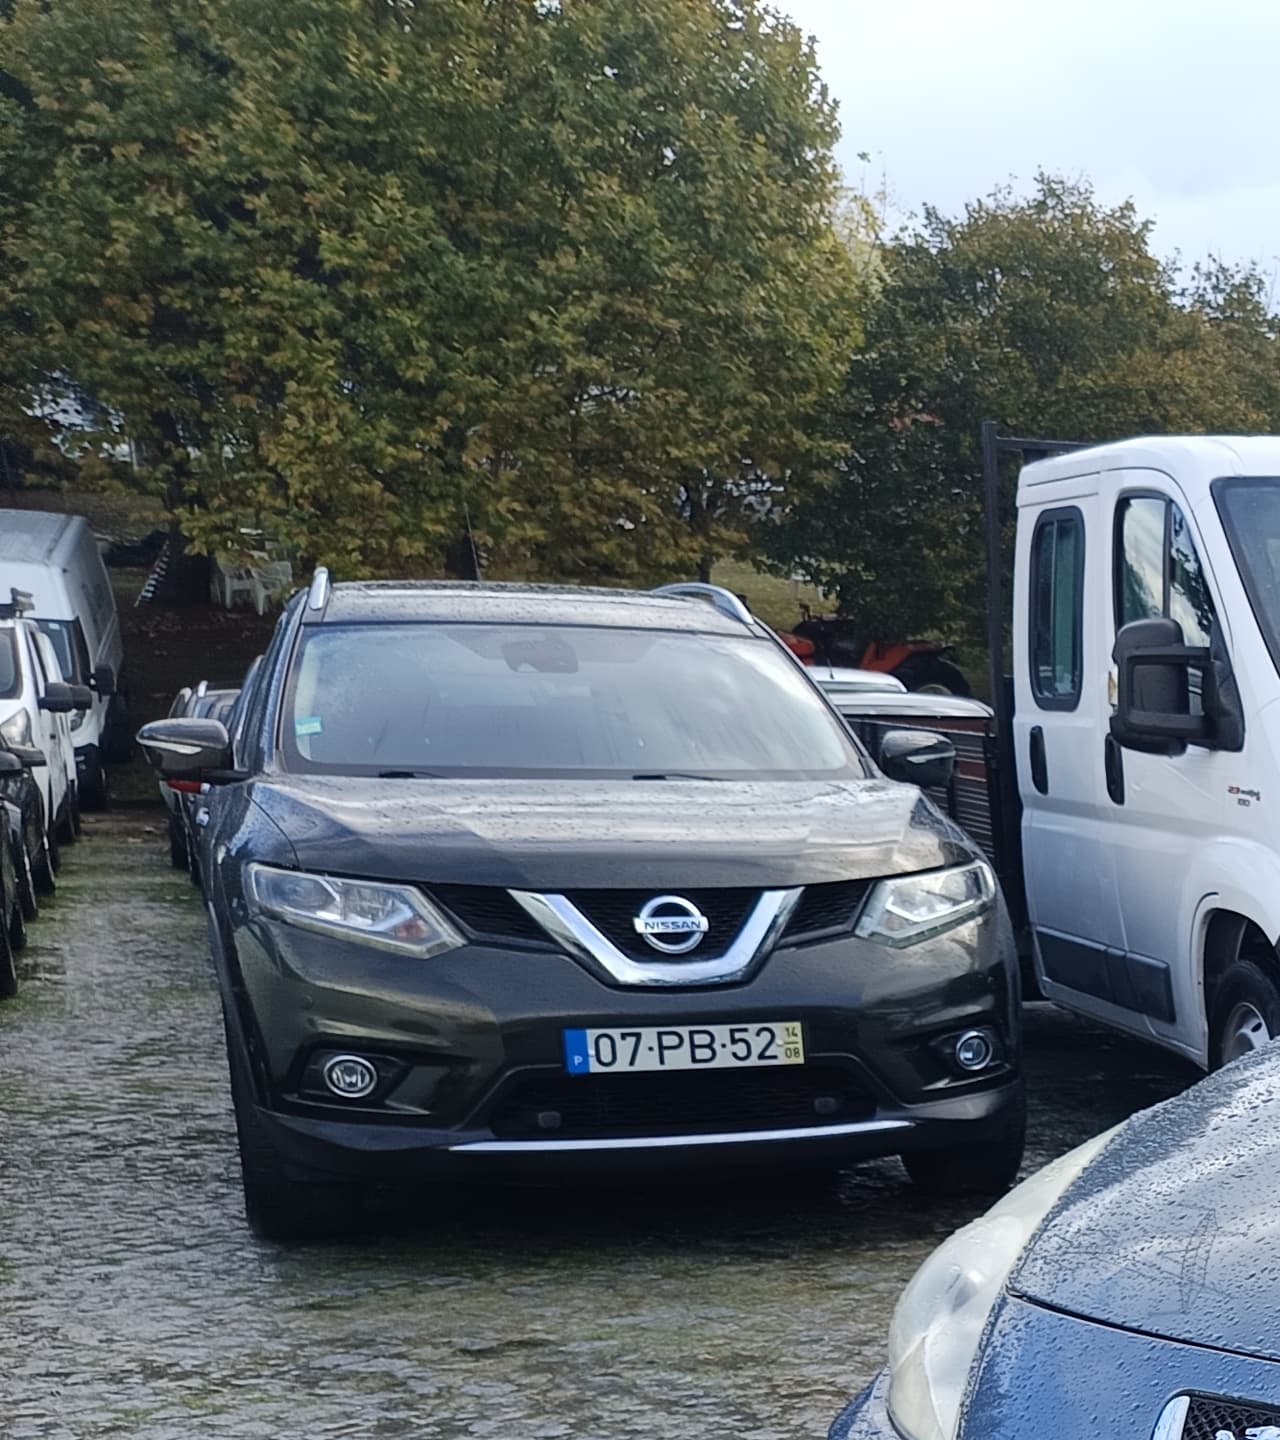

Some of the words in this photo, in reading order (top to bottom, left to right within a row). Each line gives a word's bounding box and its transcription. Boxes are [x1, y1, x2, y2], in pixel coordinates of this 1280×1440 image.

[644, 920, 701, 931] NISSAN
[785, 1027, 799, 1038] 14
[785, 1047, 801, 1059] 08
[573, 1056, 584, 1066] P
